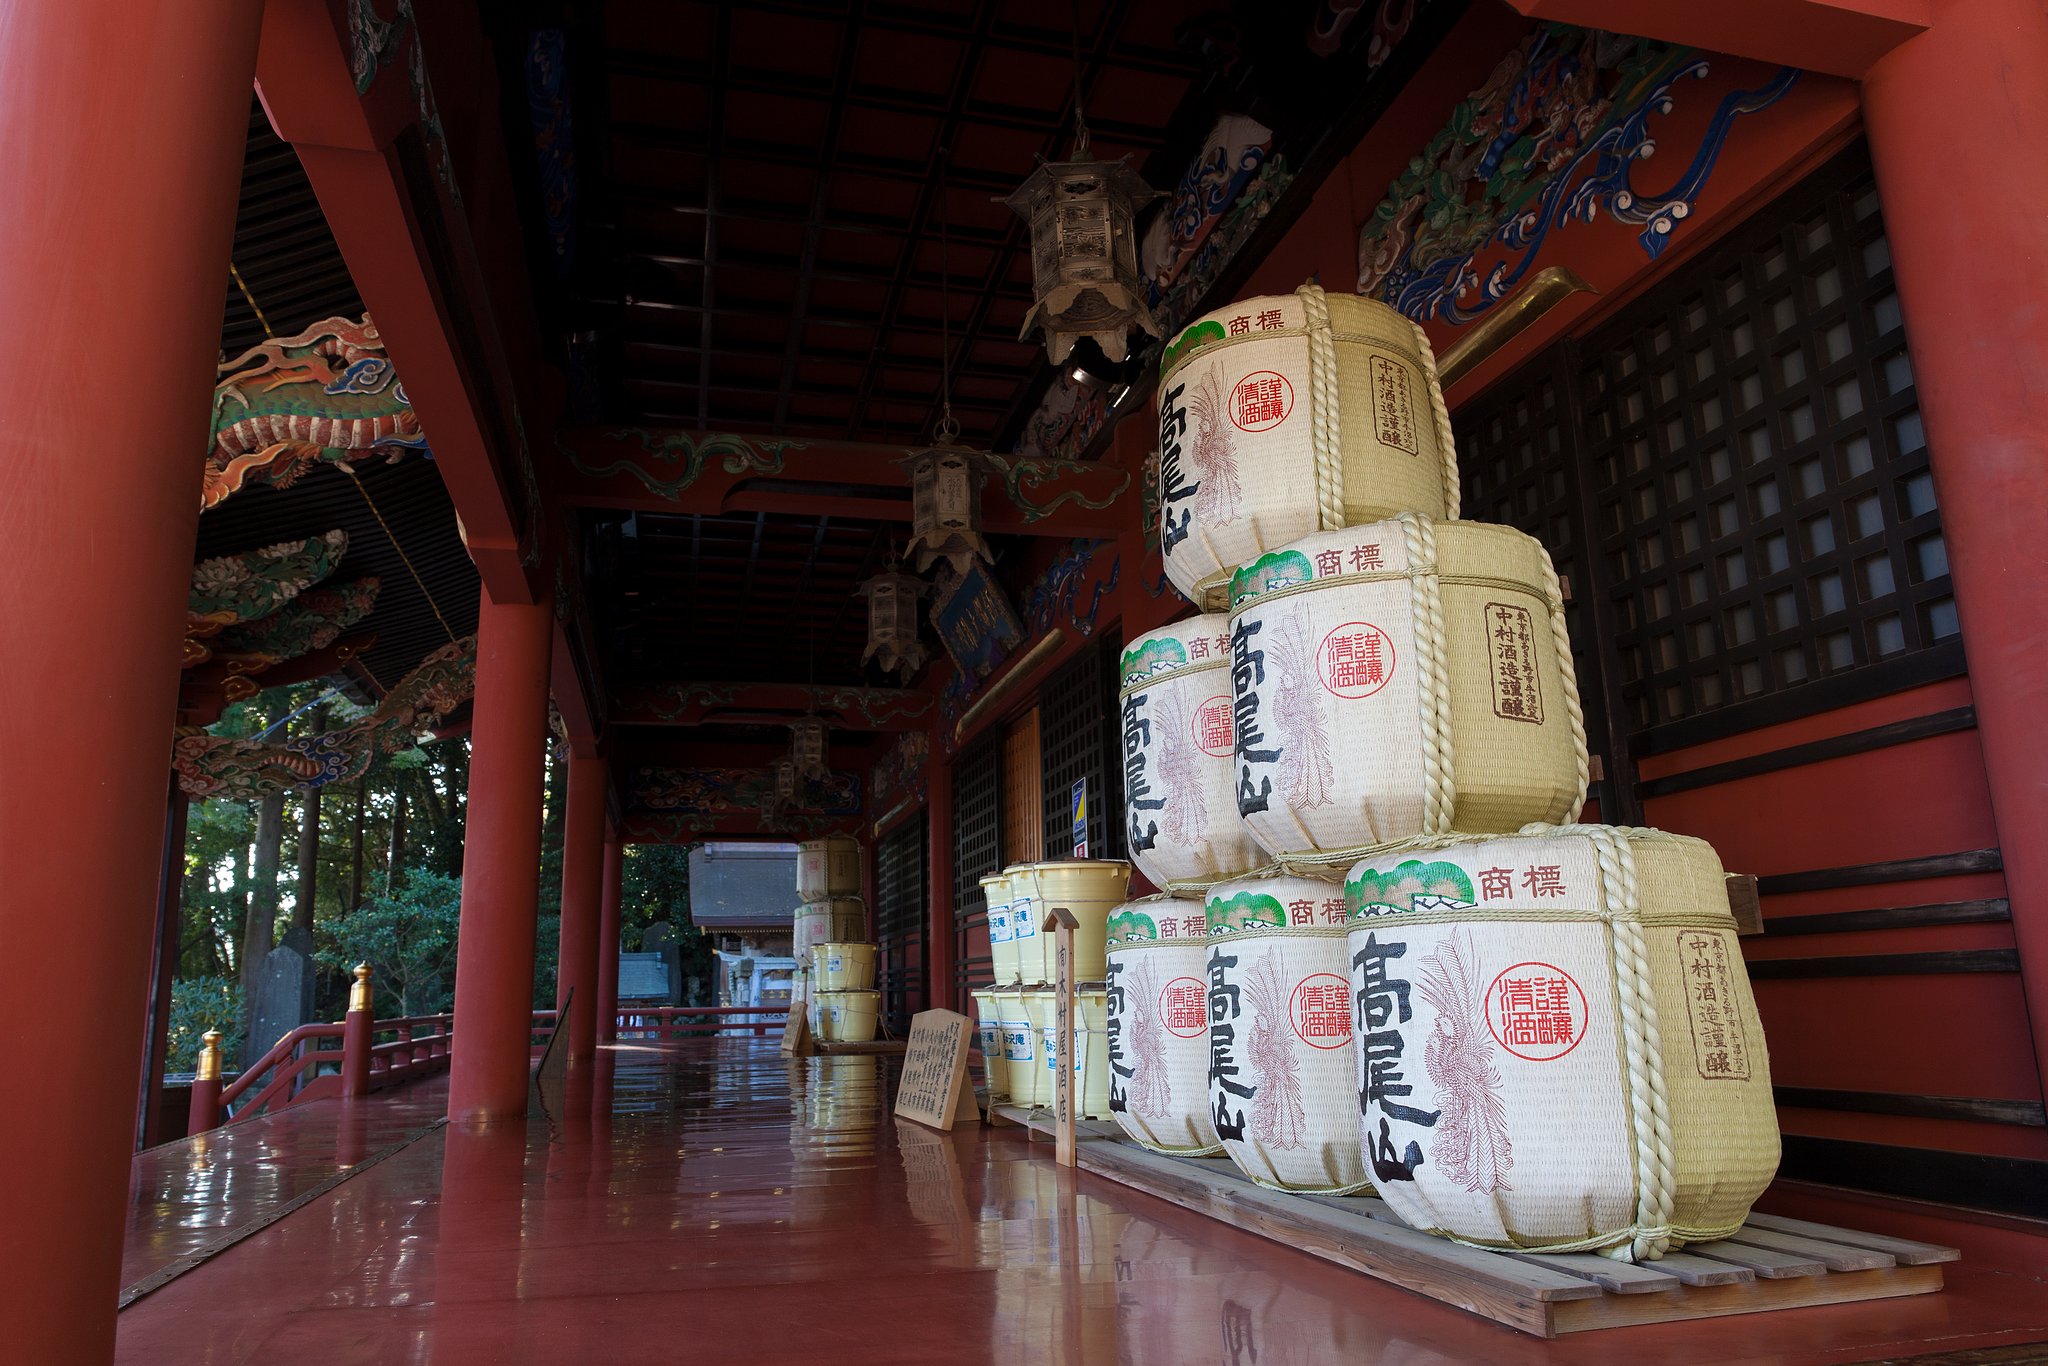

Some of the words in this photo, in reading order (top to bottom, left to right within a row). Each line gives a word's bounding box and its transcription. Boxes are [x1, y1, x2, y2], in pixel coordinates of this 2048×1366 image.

[1228, 308, 1284, 335] 商標
[1315, 543, 1384, 577] 商標
[1478, 864, 1567, 902] 商標
[1159, 915, 1208, 938] 商標
[1289, 898, 1349, 926] 商標
[1498, 977, 1539, 1046] 清酒
